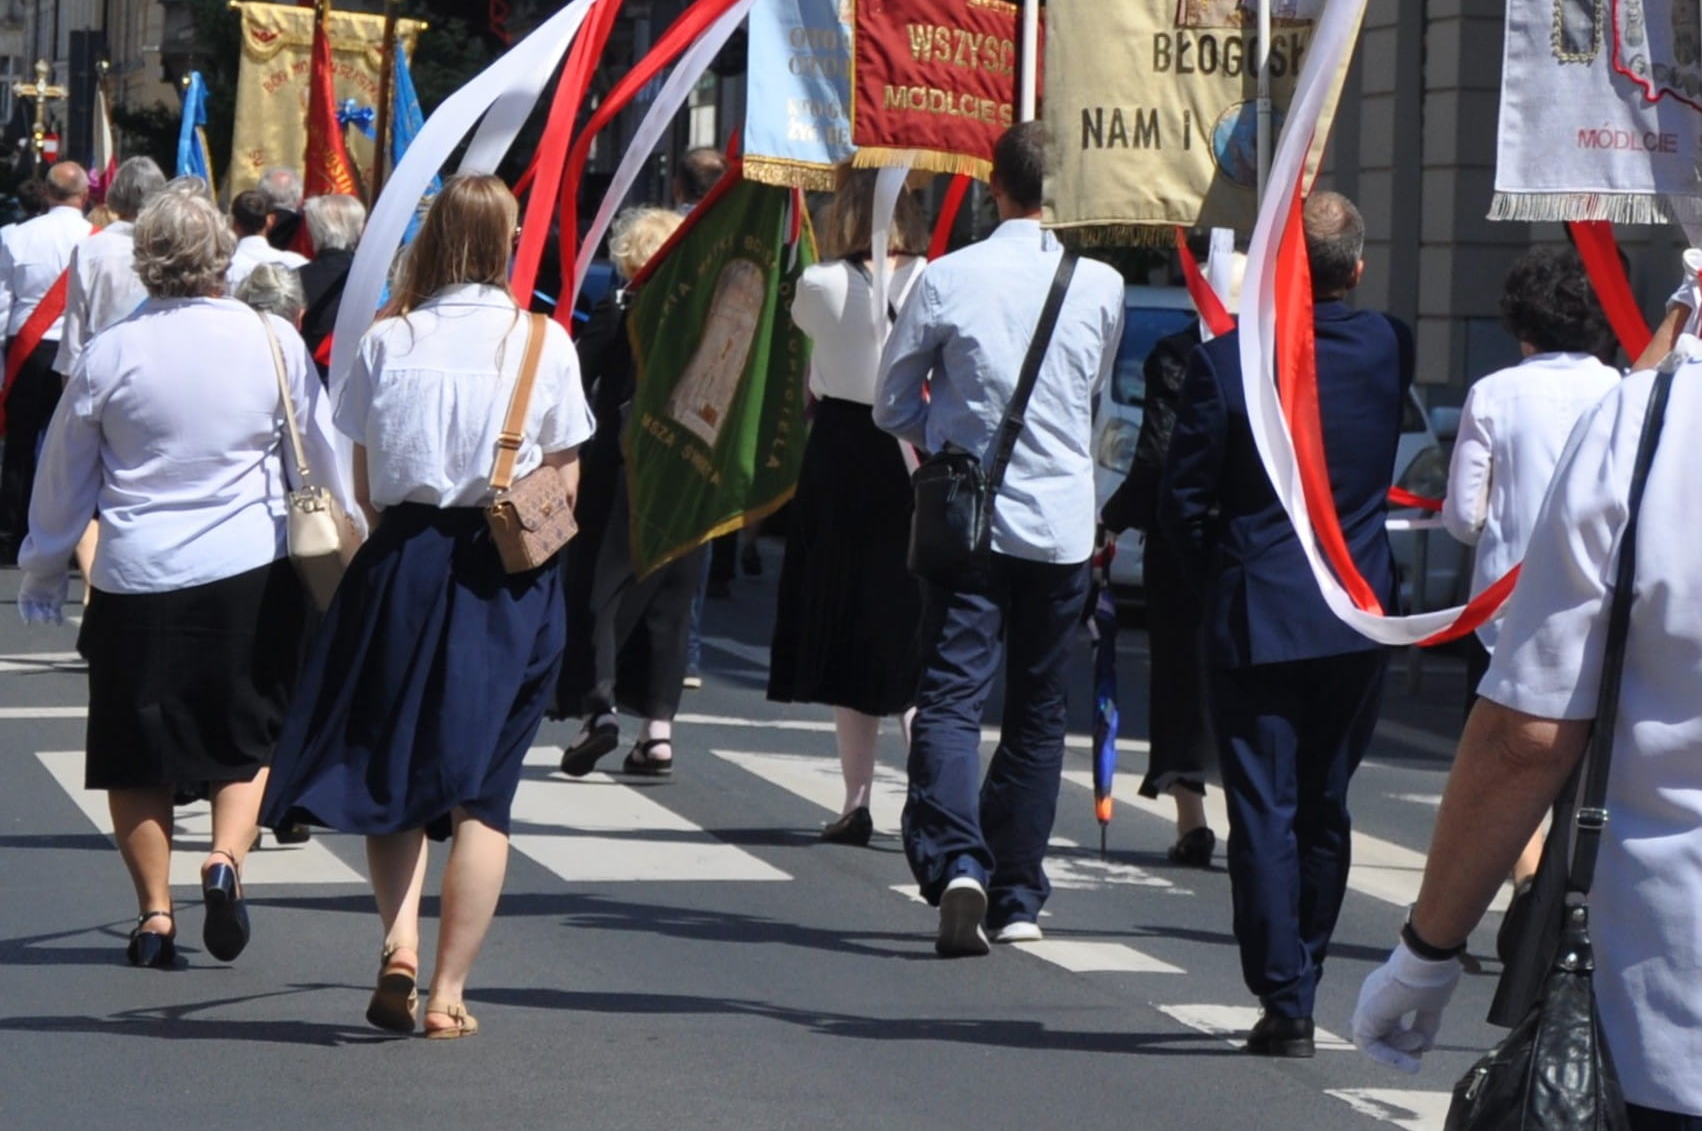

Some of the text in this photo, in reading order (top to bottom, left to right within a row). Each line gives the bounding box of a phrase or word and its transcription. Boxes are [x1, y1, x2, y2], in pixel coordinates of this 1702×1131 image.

[906, 23, 1015, 76] WSZYSC
[1081, 106, 1161, 151] NAM
[1577, 121, 1679, 154] MÓDLCIE
